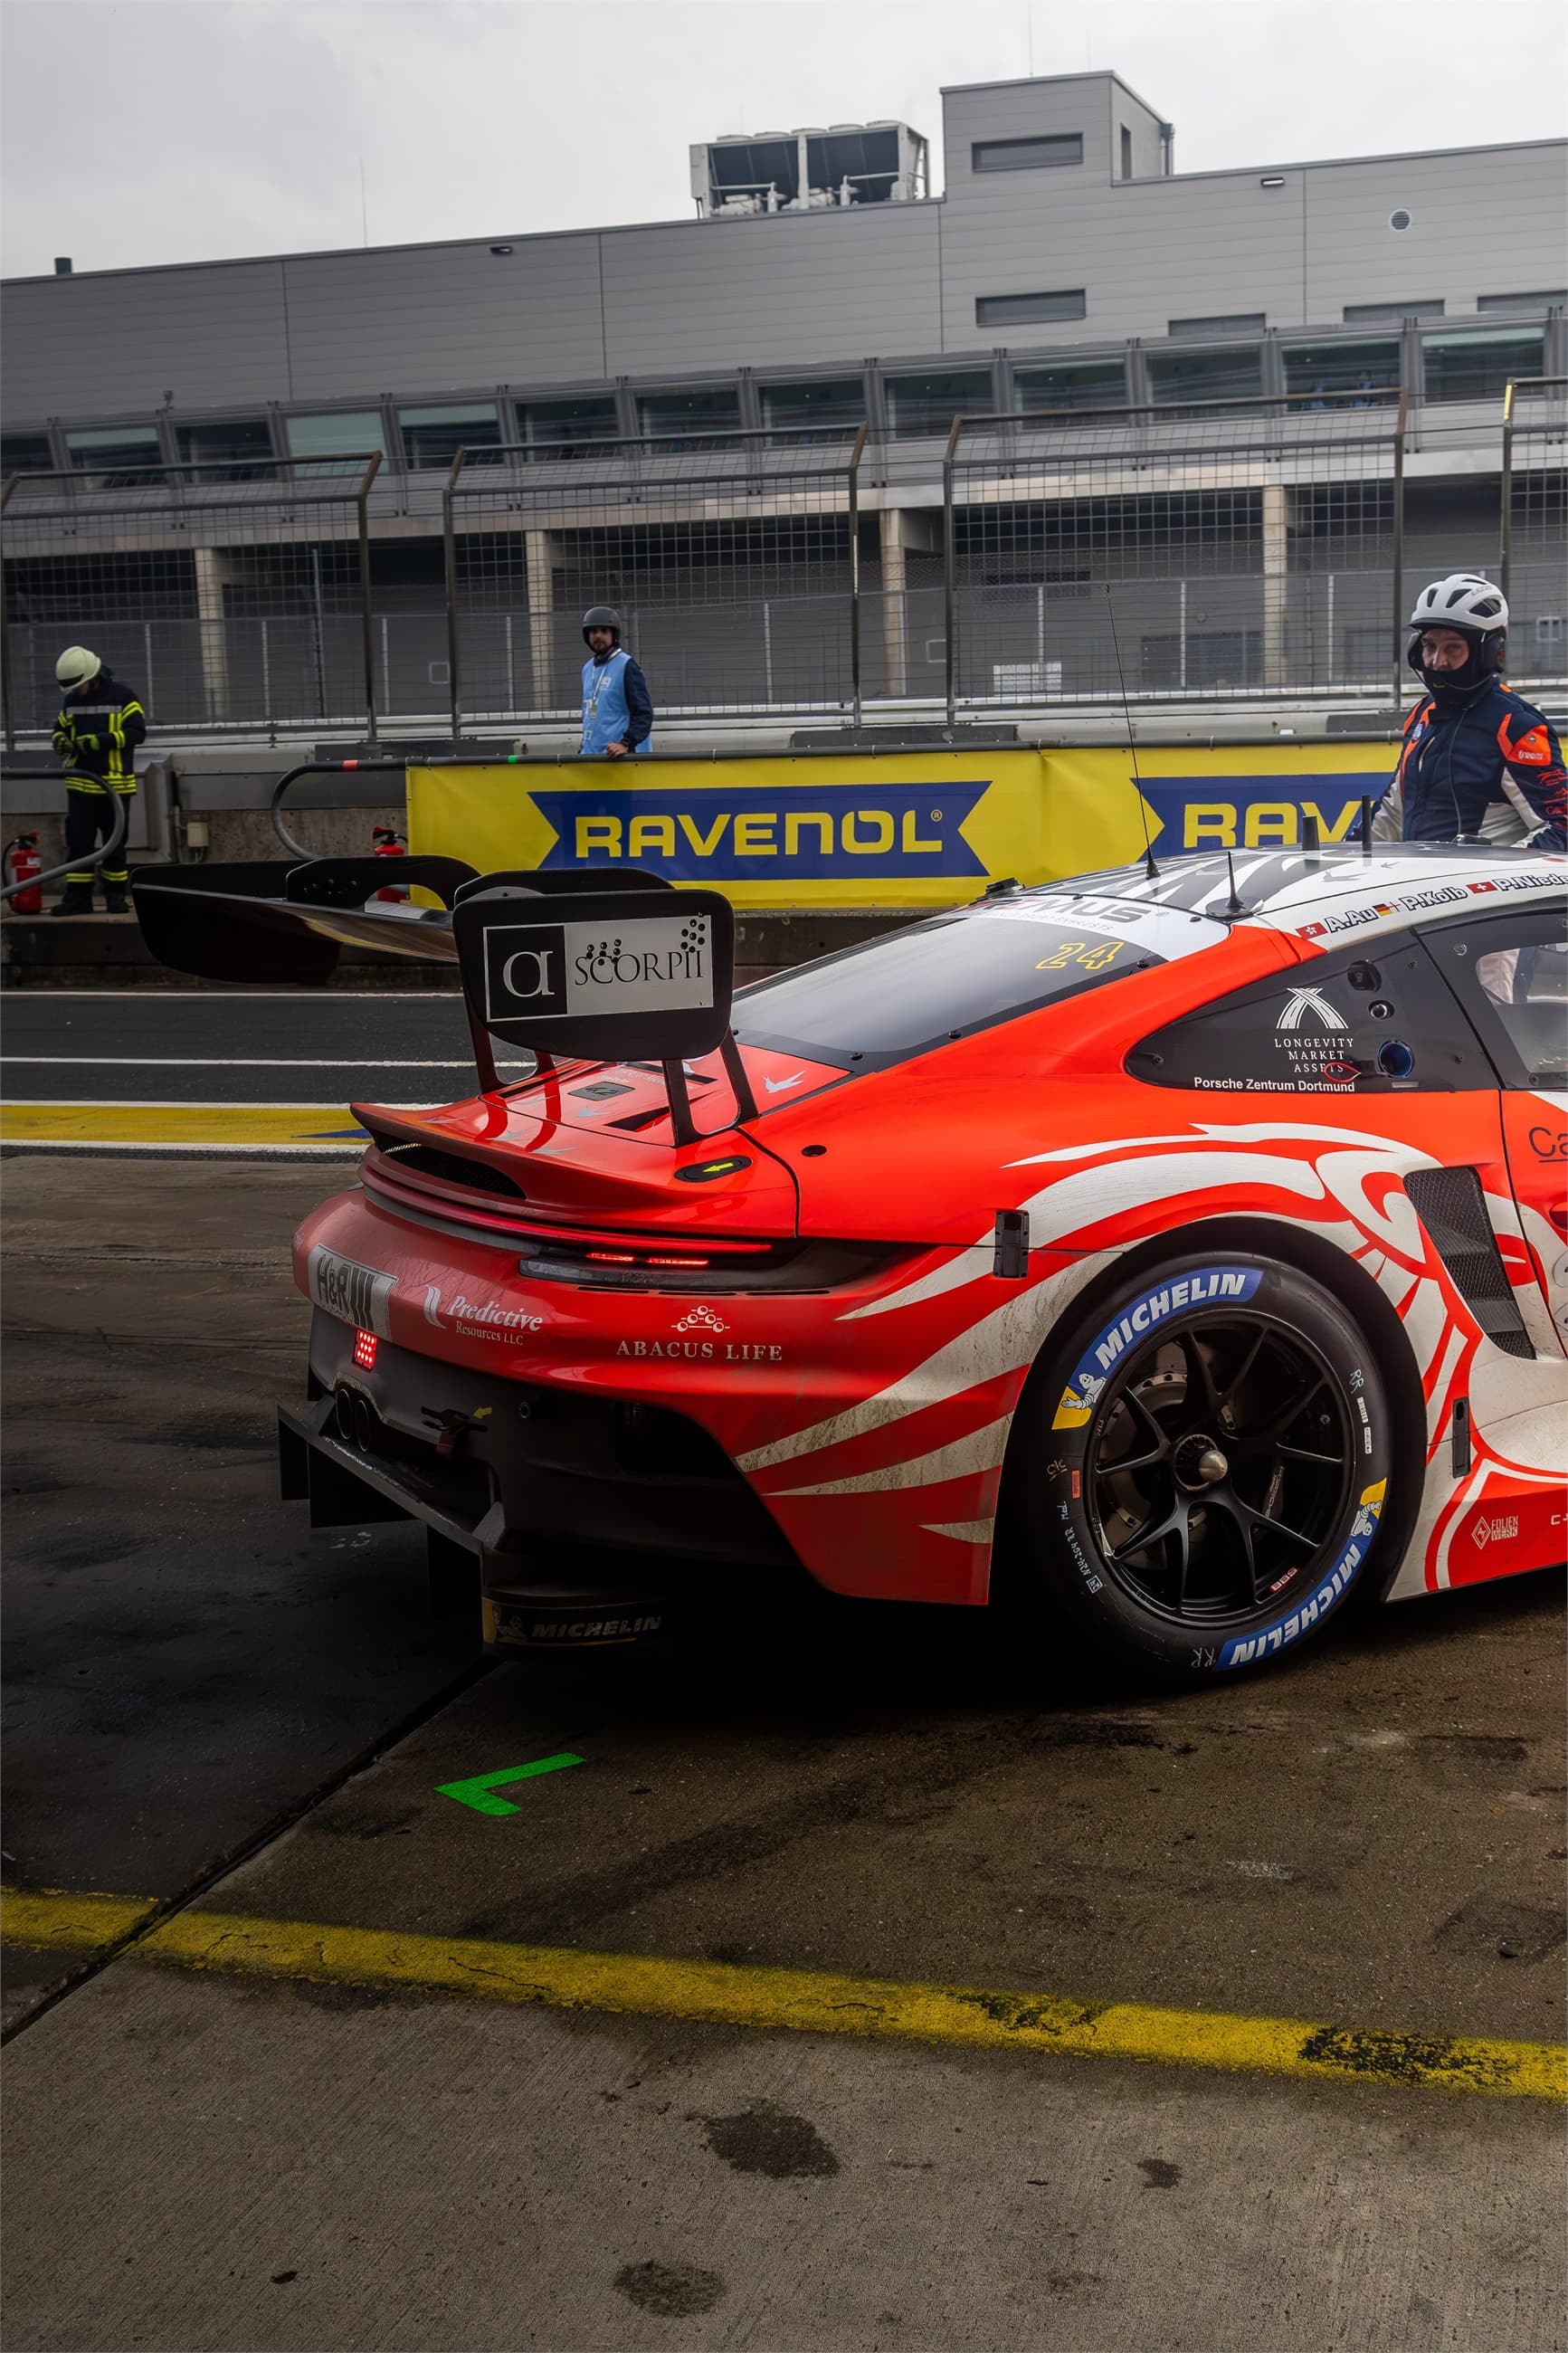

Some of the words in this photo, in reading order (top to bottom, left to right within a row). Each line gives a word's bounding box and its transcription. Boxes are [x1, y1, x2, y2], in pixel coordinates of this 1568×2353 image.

[1183, 801, 1374, 849] RAV
[1399, 887, 1468, 911] P.Kolb
[1325, 908, 1378, 933] A.Au
[575, 950, 704, 986] SCORPII
[1034, 941, 1126, 970] 24
[1274, 1038, 1354, 1048] LONGEVITY
[1288, 1051, 1345, 1061] MARKET
[1193, 1077, 1243, 1090] Porsche
[1246, 1079, 1295, 1091] Zentrum
[1297, 1081, 1355, 1092] Dortmund
[447, 1295, 543, 1332] Predictive
[1095, 1273, 1245, 1370] MICHELIN
[455, 1321, 501, 1342] Resources
[503, 1332, 524, 1346] LLC
[616, 1340, 714, 1358] ABACUS
[726, 1344, 783, 1361] LIFE
[1230, 1543, 1362, 1665] MICHELIN
[532, 1615, 662, 1637] MICHELIN
